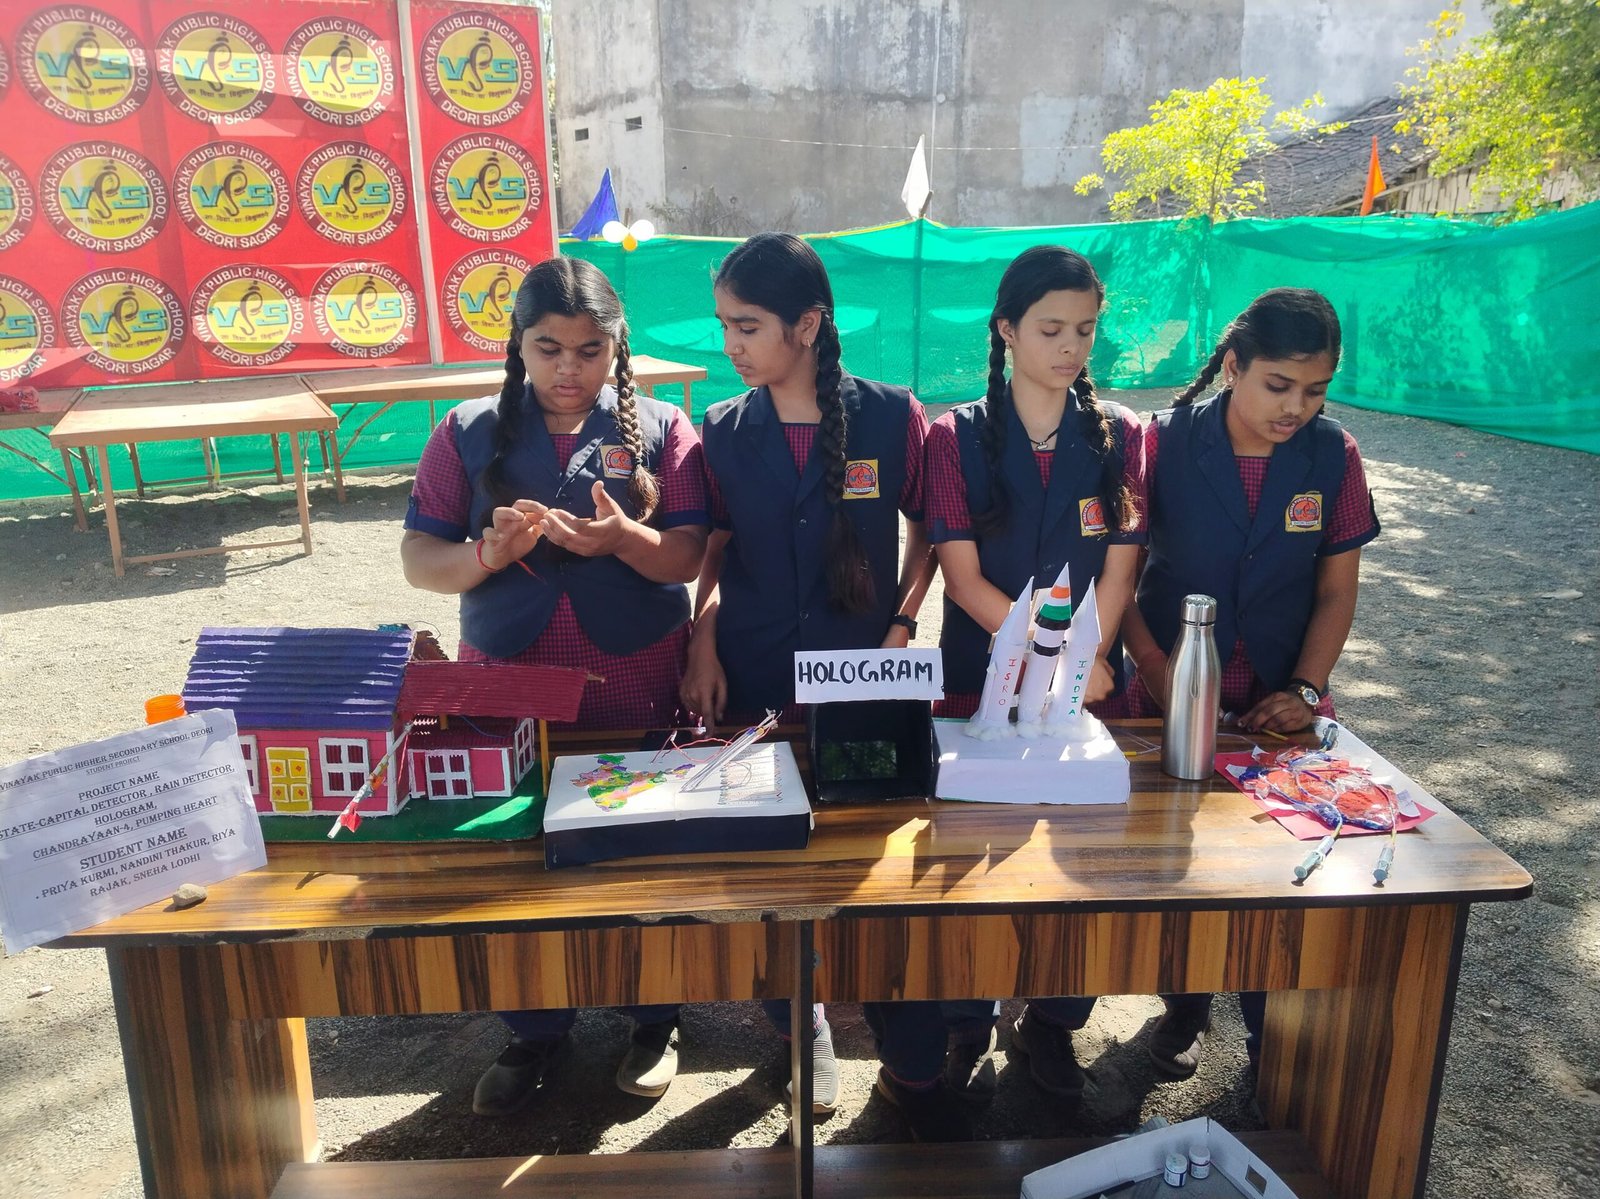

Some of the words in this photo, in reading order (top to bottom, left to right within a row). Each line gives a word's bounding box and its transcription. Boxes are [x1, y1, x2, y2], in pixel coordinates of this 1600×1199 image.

[20, 33, 42, 93] VINAYAK
[33, 8, 85, 32] PUBLIC
[91, 11, 127, 38] HIGH
[126, 38, 149, 92] SCHOOL
[159, 39, 178, 96] VINAYAK
[172, 15, 219, 39] PUBLIC
[224, 18, 257, 43] HIGH
[256, 43, 275, 94] SCHOOL
[286, 43, 303, 97] VINAYAK
[298, 20, 342, 42] PUBLIC
[346, 23, 377, 46] HIGH
[376, 46, 394, 96] SCHOOL
[424, 38, 441, 96] VINAYAK
[438, 15, 482, 38] PUBLIC
[487, 18, 517, 43] HIGH
[516, 43, 533, 95] SCHOOL
[44, 96, 90, 122] DEORI
[94, 98, 140, 124] SAGAR
[179, 99, 221, 124] DEORI
[225, 100, 267, 125] SAGAR
[303, 100, 342, 124] DEORI
[345, 101, 385, 126] SAGAR
[440, 99, 480, 125] DEORI
[483, 101, 524, 126] SAGAR
[9, 169, 33, 222] SCHOOL
[44, 169, 65, 225] VINAYAK
[57, 144, 106, 168] PUBLIC
[112, 147, 146, 170] HIGH
[145, 170, 167, 220] SCHOOL
[177, 169, 195, 222] VINAYAK
[190, 145, 235, 168] PUBLIC
[240, 147, 272, 169] HIGH
[270, 169, 290, 217] SCHOOL
[300, 168, 316, 219] VINAYAK
[312, 144, 354, 167] PUBLIC
[359, 146, 389, 168] HIGH
[387, 168, 405, 215] SCHOOL
[434, 160, 451, 215] VINAYAK
[447, 136, 491, 160] PUBLIC
[495, 139, 525, 162] HIGH
[523, 161, 541, 211] SCHOOL
[66, 227, 110, 251] DEORI
[114, 226, 159, 252] SAGAR
[196, 224, 237, 247] DEORI
[240, 223, 282, 248] SAGAR
[317, 221, 354, 244] DEORI
[358, 220, 397, 245] SAGAR
[451, 217, 489, 241] DEORI
[492, 216, 532, 242] SAGAR
[66, 297, 85, 350] VINAYAK
[78, 271, 125, 295] PUBLIC
[131, 273, 164, 294] HIGH
[163, 293, 184, 342] SCHOOL
[194, 291, 212, 343] VINAYAK
[206, 267, 251, 290] PUBLIC
[255, 269, 286, 289] HIGH
[285, 288, 304, 335] SCHOOL
[314, 286, 330, 336] VINAYAK
[325, 262, 367, 285] PUBLIC
[371, 264, 400, 284] HIGH
[399, 283, 416, 328] SCHOOL
[446, 276, 462, 329] VINAYAK
[458, 252, 500, 275] PUBLIC
[32, 299, 55, 348] SCHOOL
[330, 337, 367, 357] DEORI
[370, 333, 408, 358] SAGAR
[463, 330, 500, 352] DEORI
[0, 354, 47, 381] SAGAR
[86, 351, 129, 373] DEORI
[132, 347, 176, 373] SAGAR
[213, 344, 252, 365] DEORI
[256, 340, 296, 366] SAGAR
[798, 659, 933, 687] HOLOGRAM
[998, 658, 1017, 706] ISRO
[1068, 660, 1087, 715] INDIA
[0, 773, 40, 790] VINAYAK
[42, 764, 73, 778] PUBLIC
[75, 755, 107, 769] HIGHER
[109, 740, 157, 760] SECONDARY
[191, 726, 214, 738] DEORI
[86, 764, 114, 775] STUDENT
[115, 755, 140, 767] PROJECT
[78, 780, 127, 801] PROJECT
[129, 771, 160, 787] NAME
[91, 789, 147, 811] DETECTOR
[154, 779, 180, 794] RAIN
[182, 764, 235, 785] DETECTOR,
[33, 823, 134, 859] CHANDRAYAAN-4,
[135, 807, 181, 827] PUMPING
[183, 795, 218, 813] HEART
[94, 801, 158, 825] HOLOGRAM,
[42, 880, 78, 898] PRIYA
[80, 866, 119, 886] KURMI,
[120, 852, 163, 872] NANDINI
[165, 837, 210, 857] THAKUR,
[211, 828, 236, 843] RIYA
[80, 841, 143, 870] STUDENT
[147, 827, 188, 849] NAME
[89, 877, 132, 897] RAJAK,
[133, 865, 169, 882] SNEHA
[170, 853, 201, 869] LODHI
